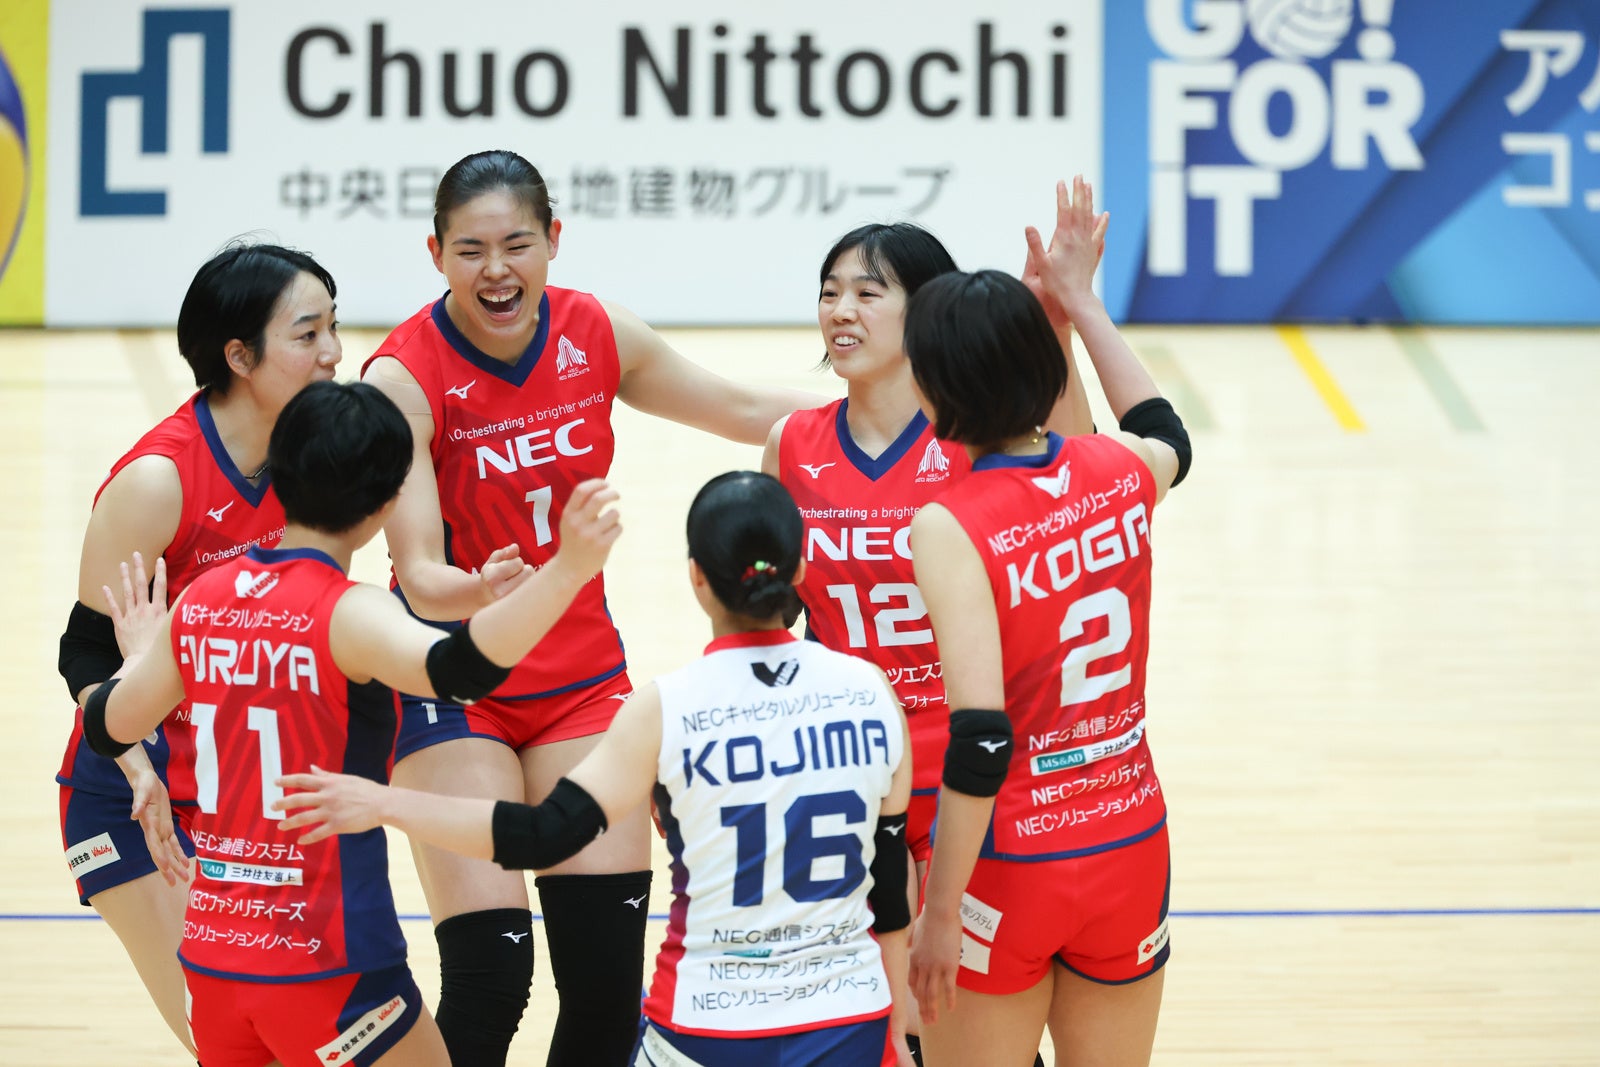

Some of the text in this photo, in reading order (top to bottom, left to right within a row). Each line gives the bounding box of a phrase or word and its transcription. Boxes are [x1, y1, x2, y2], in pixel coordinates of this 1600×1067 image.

[284, 22, 1072, 120] Chuo Nittochi
[1501, 30, 1600, 117] ア
[1147, 58, 1427, 171] FOR
[279, 164, 954, 220] 中央日地建物グループ
[1502, 132, 1600, 212] コ
[1146, 165, 1282, 278] IT
[527, 413, 534, 424] a
[536, 402, 577, 422] brighter
[578, 391, 605, 410] world
[475, 417, 594, 480] NEC
[525, 485, 553, 547] 1
[870, 509, 878, 518] a
[1006, 501, 1152, 609] KOGA
[826, 582, 934, 648] 12
[1059, 586, 1132, 707] 2
[190, 702, 287, 821] 11
[682, 719, 890, 789] KOJIMA
[720, 789, 868, 907] 16
[184, 920, 322, 955] ECソリューションイノベータ
